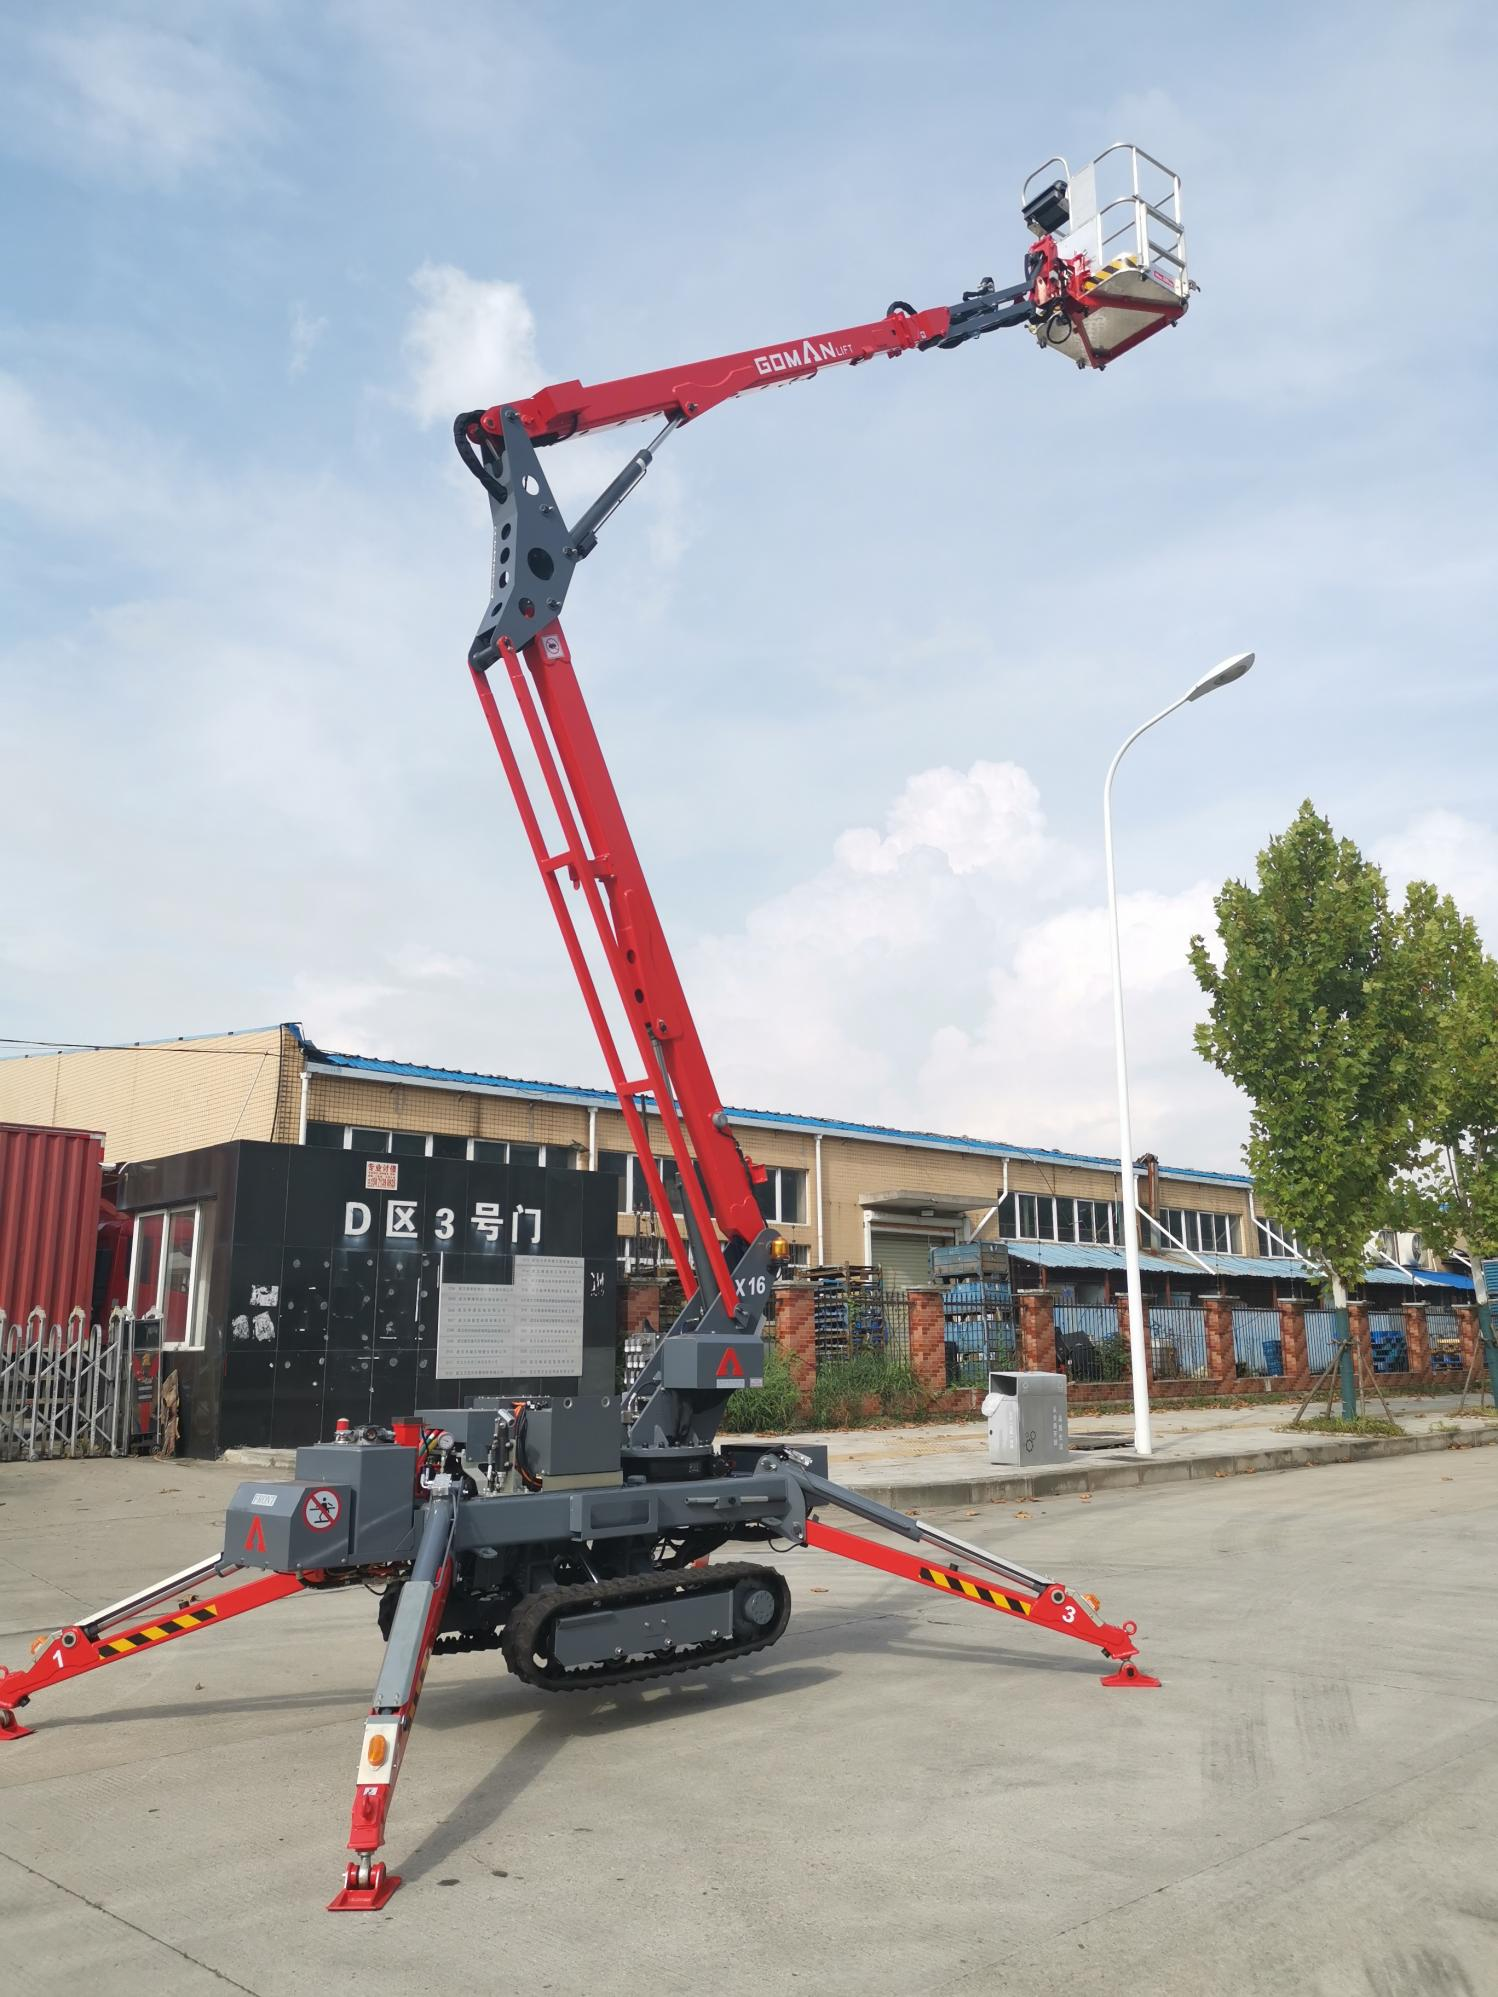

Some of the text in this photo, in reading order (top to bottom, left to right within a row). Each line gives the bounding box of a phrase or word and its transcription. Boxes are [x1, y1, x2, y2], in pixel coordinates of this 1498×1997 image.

[754, 340, 853, 375] GOMAN LIFT
[1062, 1605, 1076, 1623] 3
[52, 1649, 64, 1668] 1
